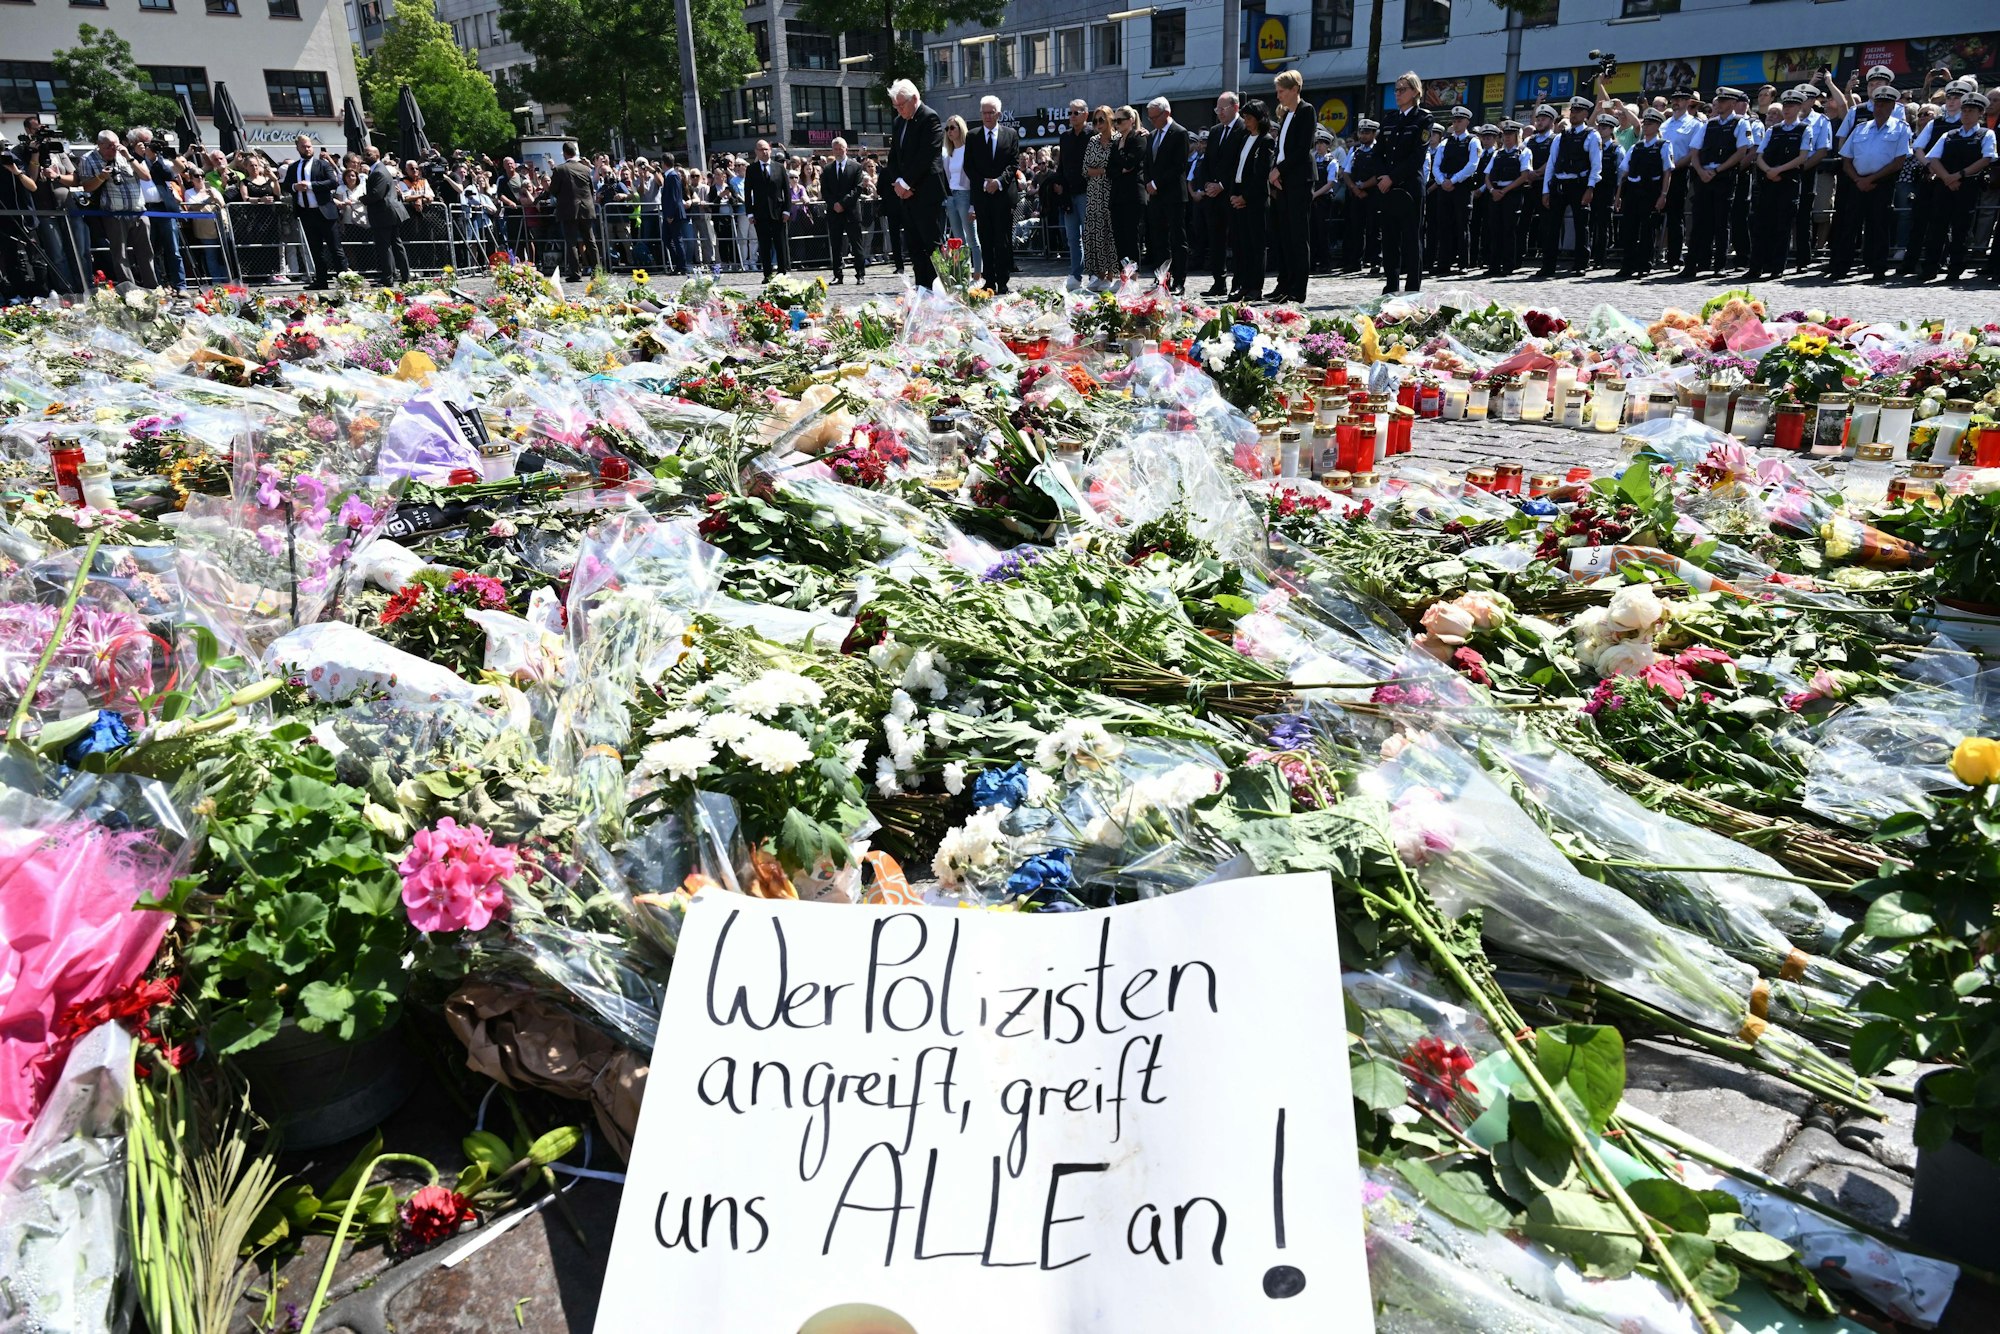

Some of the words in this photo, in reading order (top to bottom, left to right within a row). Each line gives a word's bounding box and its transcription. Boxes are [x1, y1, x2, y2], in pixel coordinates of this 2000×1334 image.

[808, 130, 833, 140] PROJEKT
[706, 909, 855, 1032] Wer
[865, 912, 1219, 1044] Polizisten
[697, 1046, 971, 1182] angreift,
[1001, 1033, 1168, 1179] greift
[655, 1191, 769, 1254] uns
[822, 1141, 1111, 1271] ALLE
